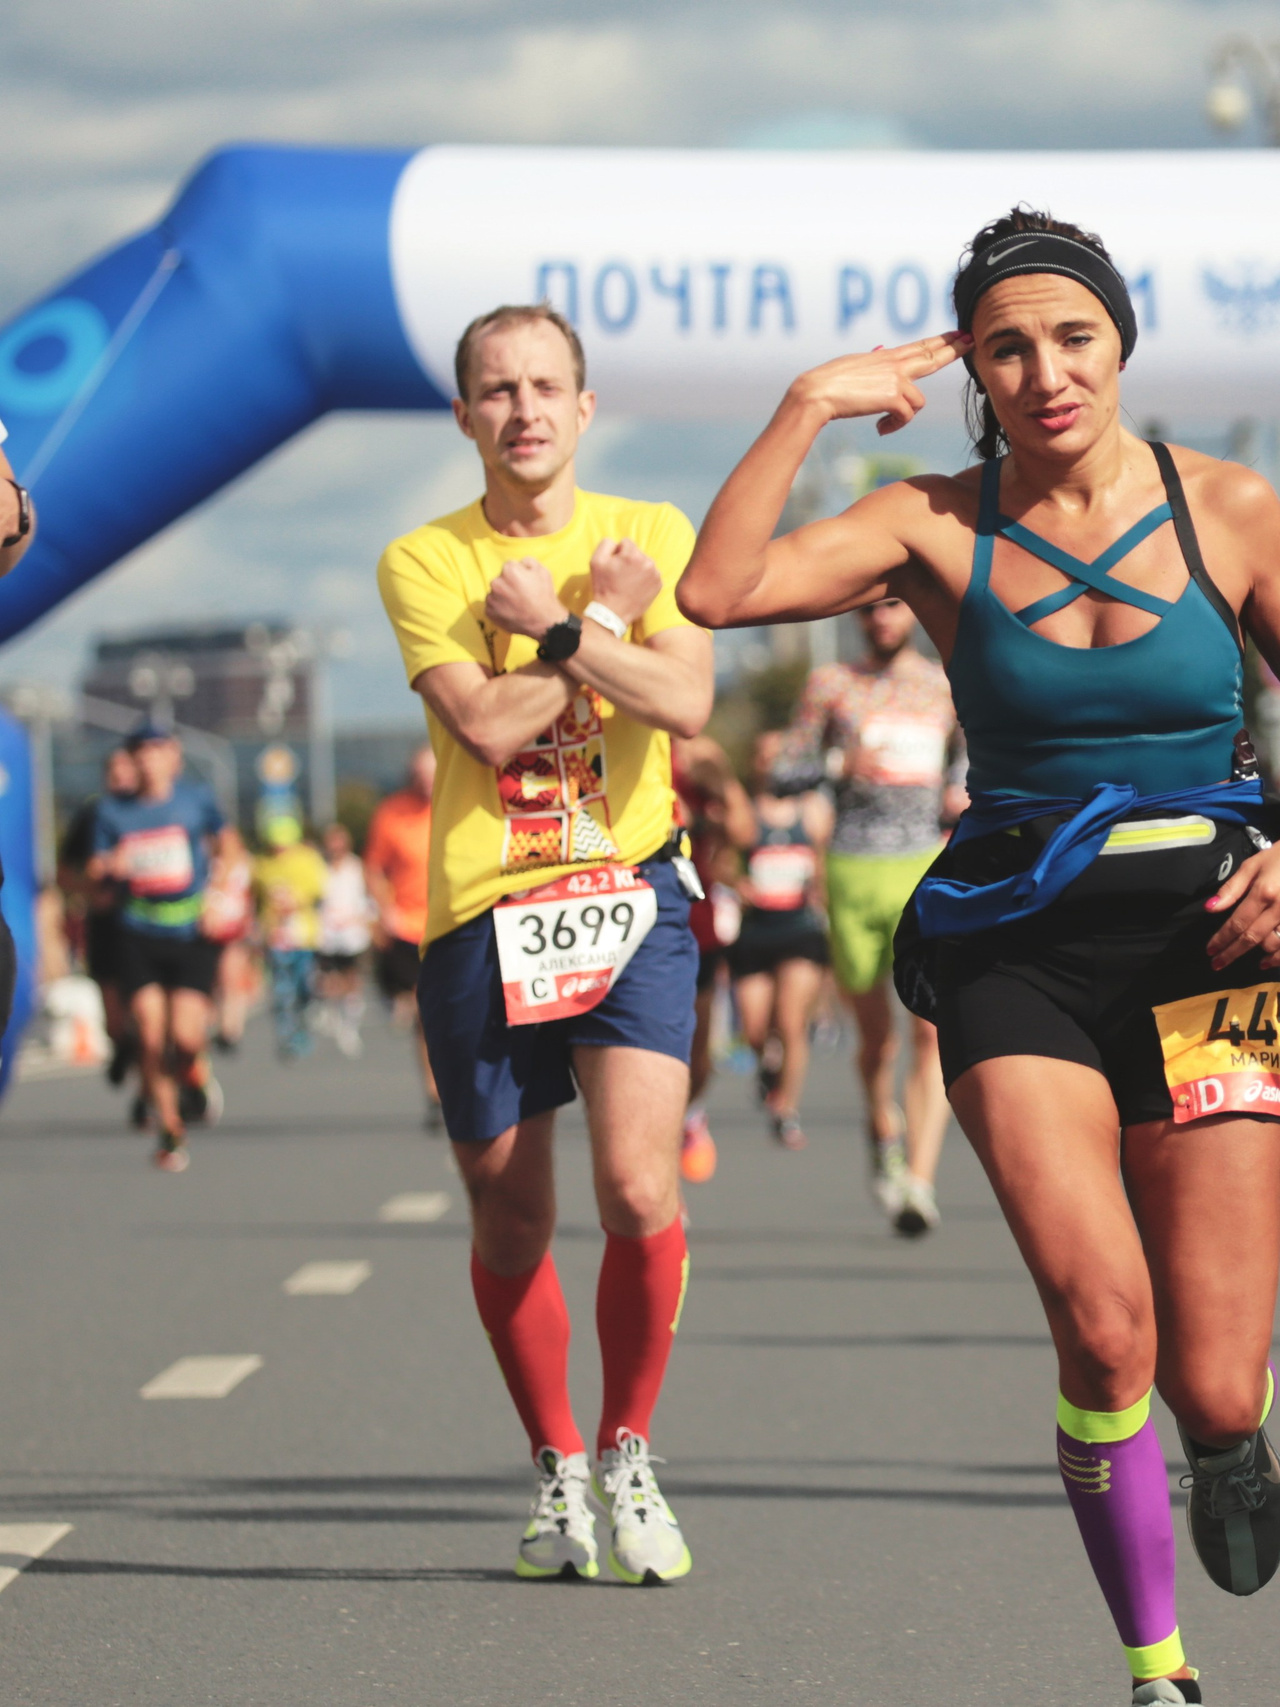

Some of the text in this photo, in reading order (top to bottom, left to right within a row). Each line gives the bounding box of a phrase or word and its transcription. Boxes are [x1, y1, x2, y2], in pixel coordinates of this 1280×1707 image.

[534, 258, 797, 336] ПОЧТА
[567, 871, 611, 894] 42,2
[519, 902, 635, 955] 3699
[1197, 1077, 1224, 1113] D
